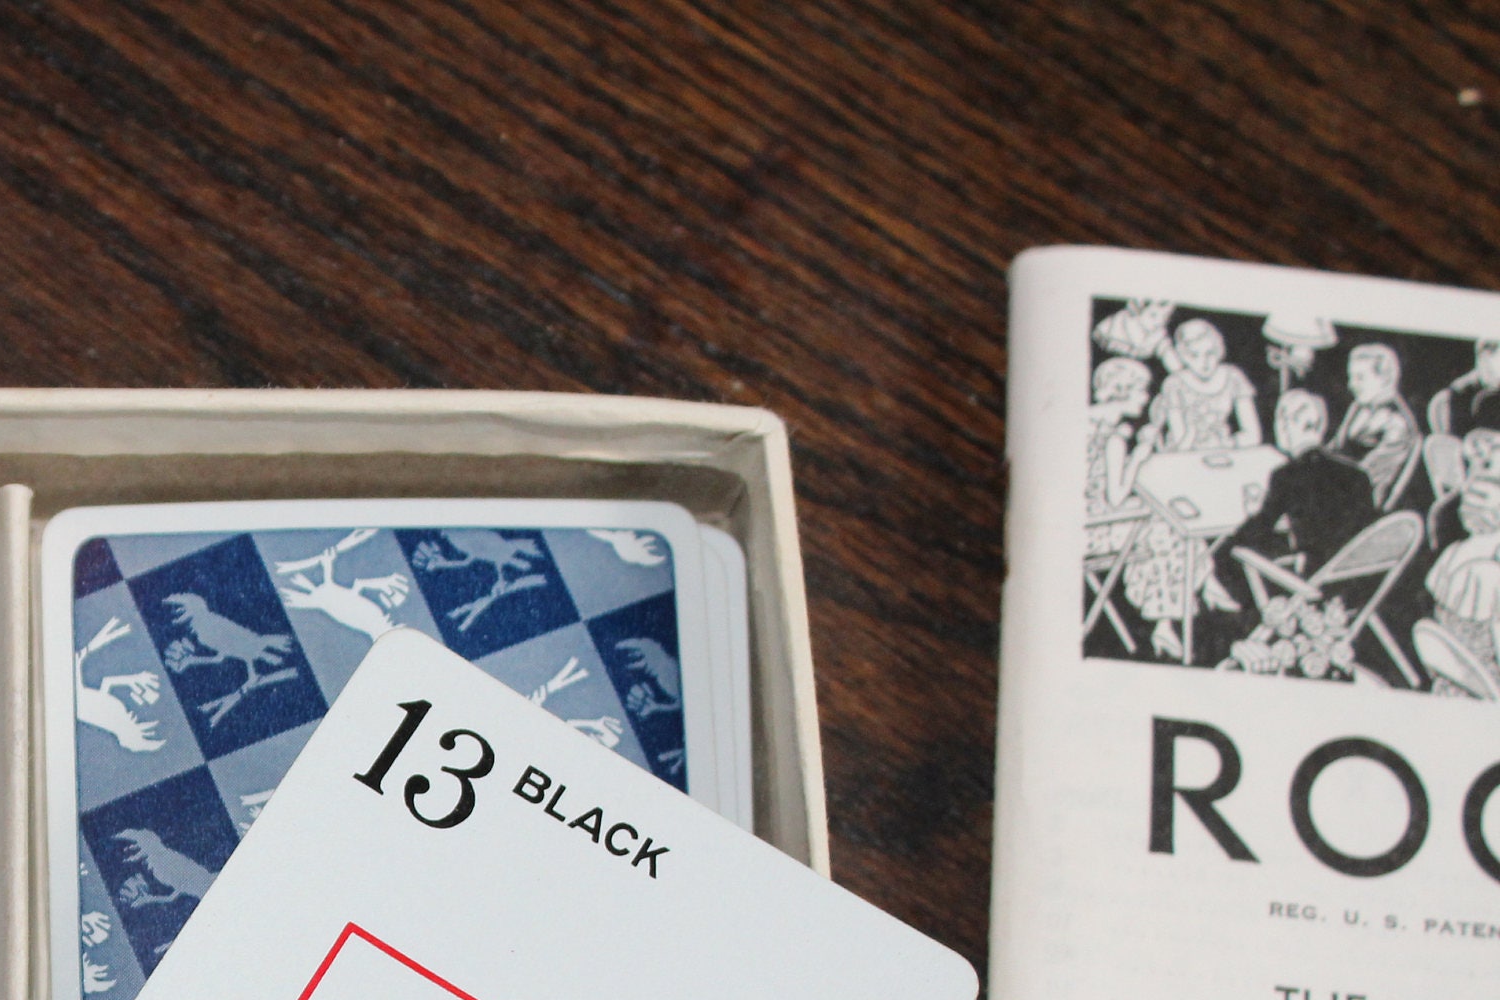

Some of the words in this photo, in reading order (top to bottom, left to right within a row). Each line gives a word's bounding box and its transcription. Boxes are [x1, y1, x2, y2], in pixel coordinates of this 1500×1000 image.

[352, 698, 496, 829] 13
[511, 764, 671, 880] BLACK
[1148, 714, 1500, 886] RO
[1268, 901, 1327, 922] REG.
[1343, 909, 1368, 927] U.
[1384, 914, 1407, 931] S.
